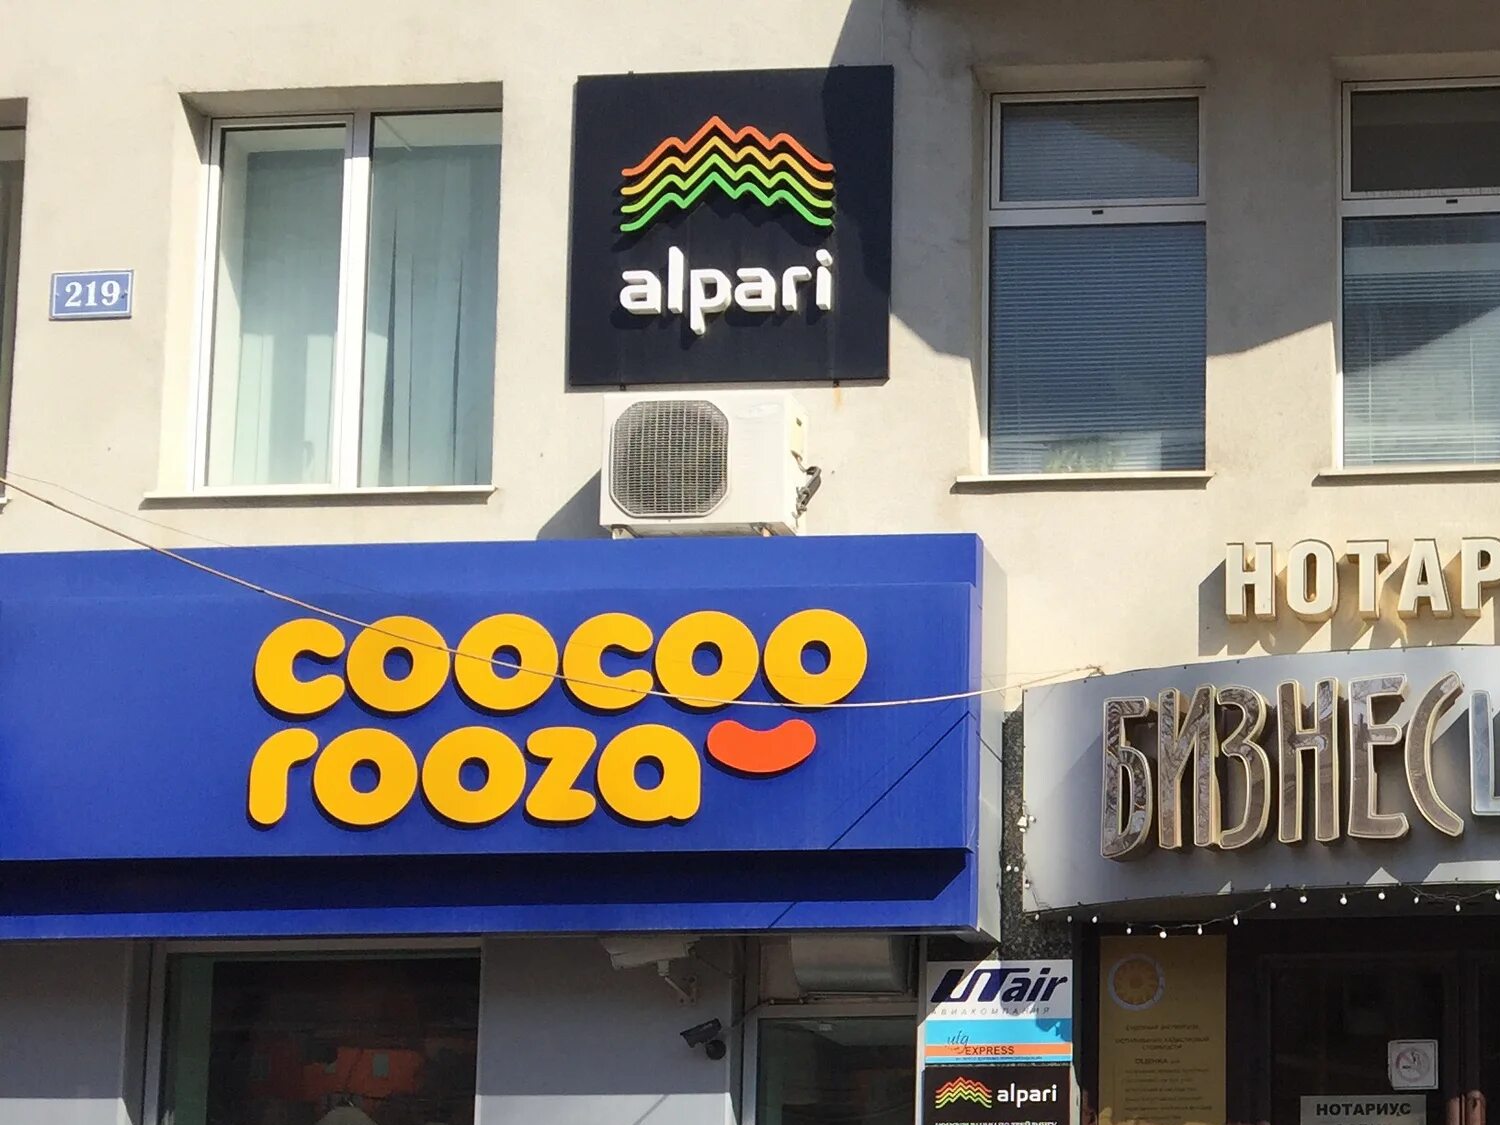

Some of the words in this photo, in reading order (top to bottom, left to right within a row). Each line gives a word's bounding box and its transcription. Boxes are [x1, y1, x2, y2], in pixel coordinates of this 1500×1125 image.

[64, 280, 122, 307] 219
[620, 246, 834, 335] alpari
[254, 608, 869, 714] coocoo
[249, 723, 703, 828] rooza
[930, 967, 1068, 1003] UTair
[965, 1045, 1015, 1056] EXPRESS
[997, 1082, 1057, 1108] alpari
[1315, 1102, 1412, 1117] НОТАРИУС
